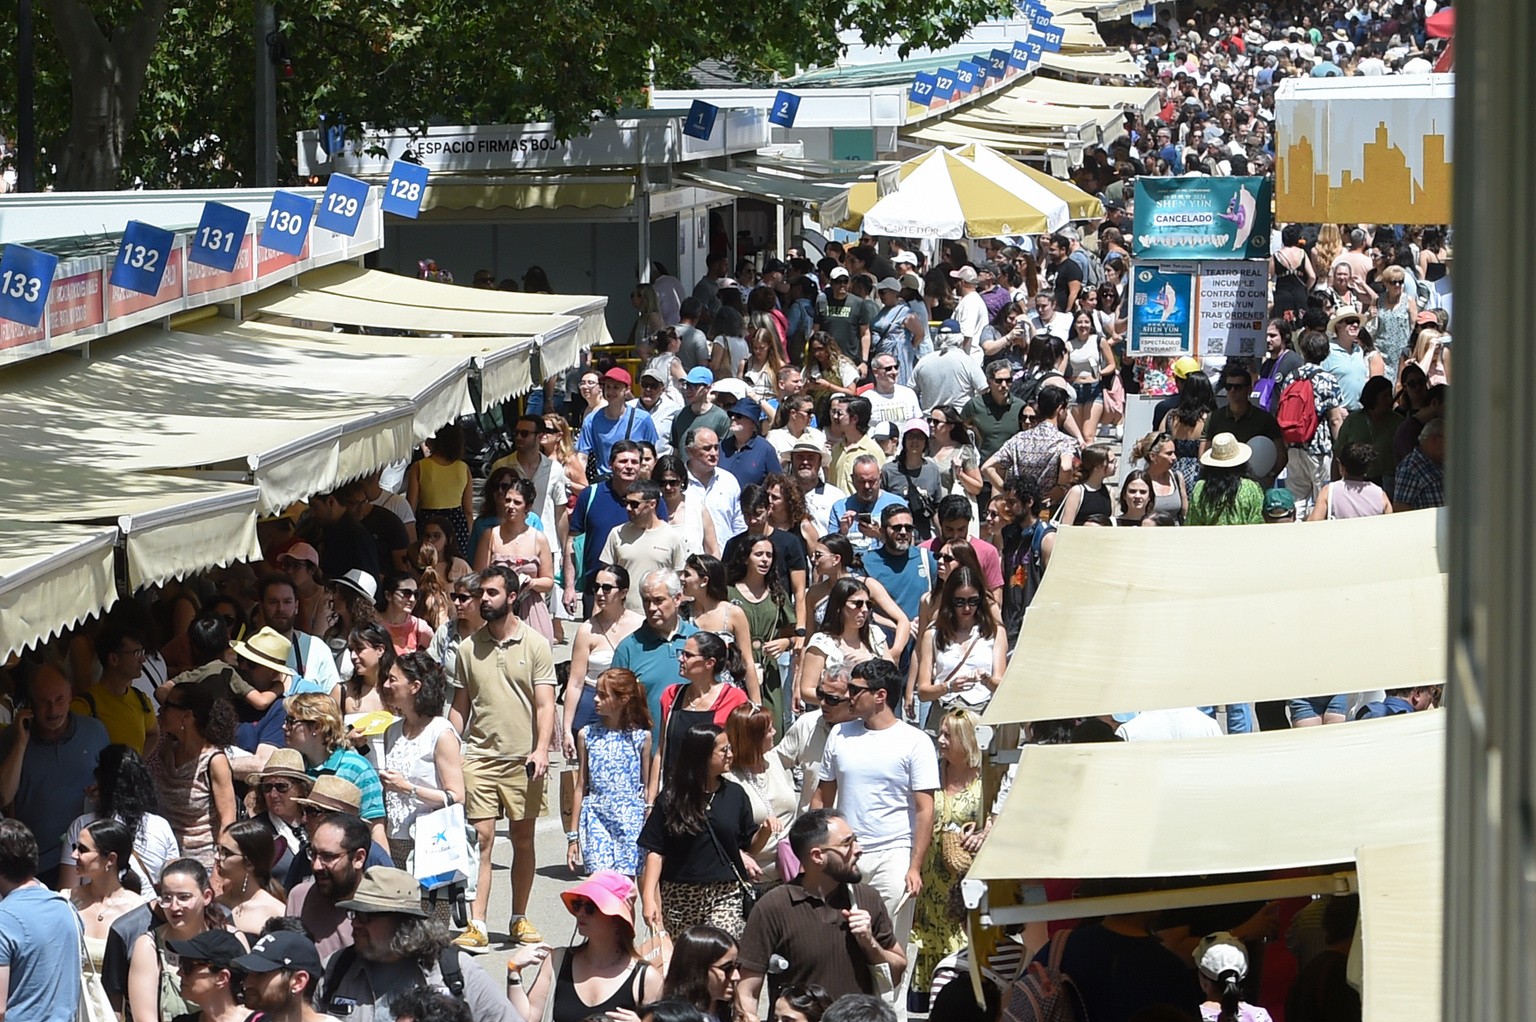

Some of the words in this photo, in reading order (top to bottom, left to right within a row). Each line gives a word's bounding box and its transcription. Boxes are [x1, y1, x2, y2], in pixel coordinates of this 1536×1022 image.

[1046, 32, 1060, 44] 121
[1027, 42, 1041, 54] 22
[1012, 48, 1028, 62] 123
[990, 58, 1005, 70] 24
[956, 69, 973, 83] 126
[914, 81, 933, 96] 127
[936, 76, 953, 90] 127
[782, 101, 789, 113] 2
[698, 112, 704, 124] 1
[418, 141, 475, 155] ESPACIO
[477, 139, 528, 153] FIRMAS
[390, 178, 421, 201] 128
[327, 193, 359, 218] 129
[1155, 200, 1185, 208] SHEN
[1189, 200, 1212, 208] YUN
[269, 209, 303, 236] 130
[1156, 214, 1212, 223] CANCELADO
[201, 226, 235, 253] 131
[123, 242, 160, 273] 132
[1206, 269, 1238, 277] TEATRO
[1241, 269, 1262, 277] REAL
[1, 270, 42, 303] 133
[1201, 290, 1246, 298] CONTRATO
[1247, 290, 1266, 298] CON
[1201, 311, 1223, 319] TRAS
[1224, 310, 1264, 319] ÓRDENES
[1226, 321, 1252, 329] CHINA
